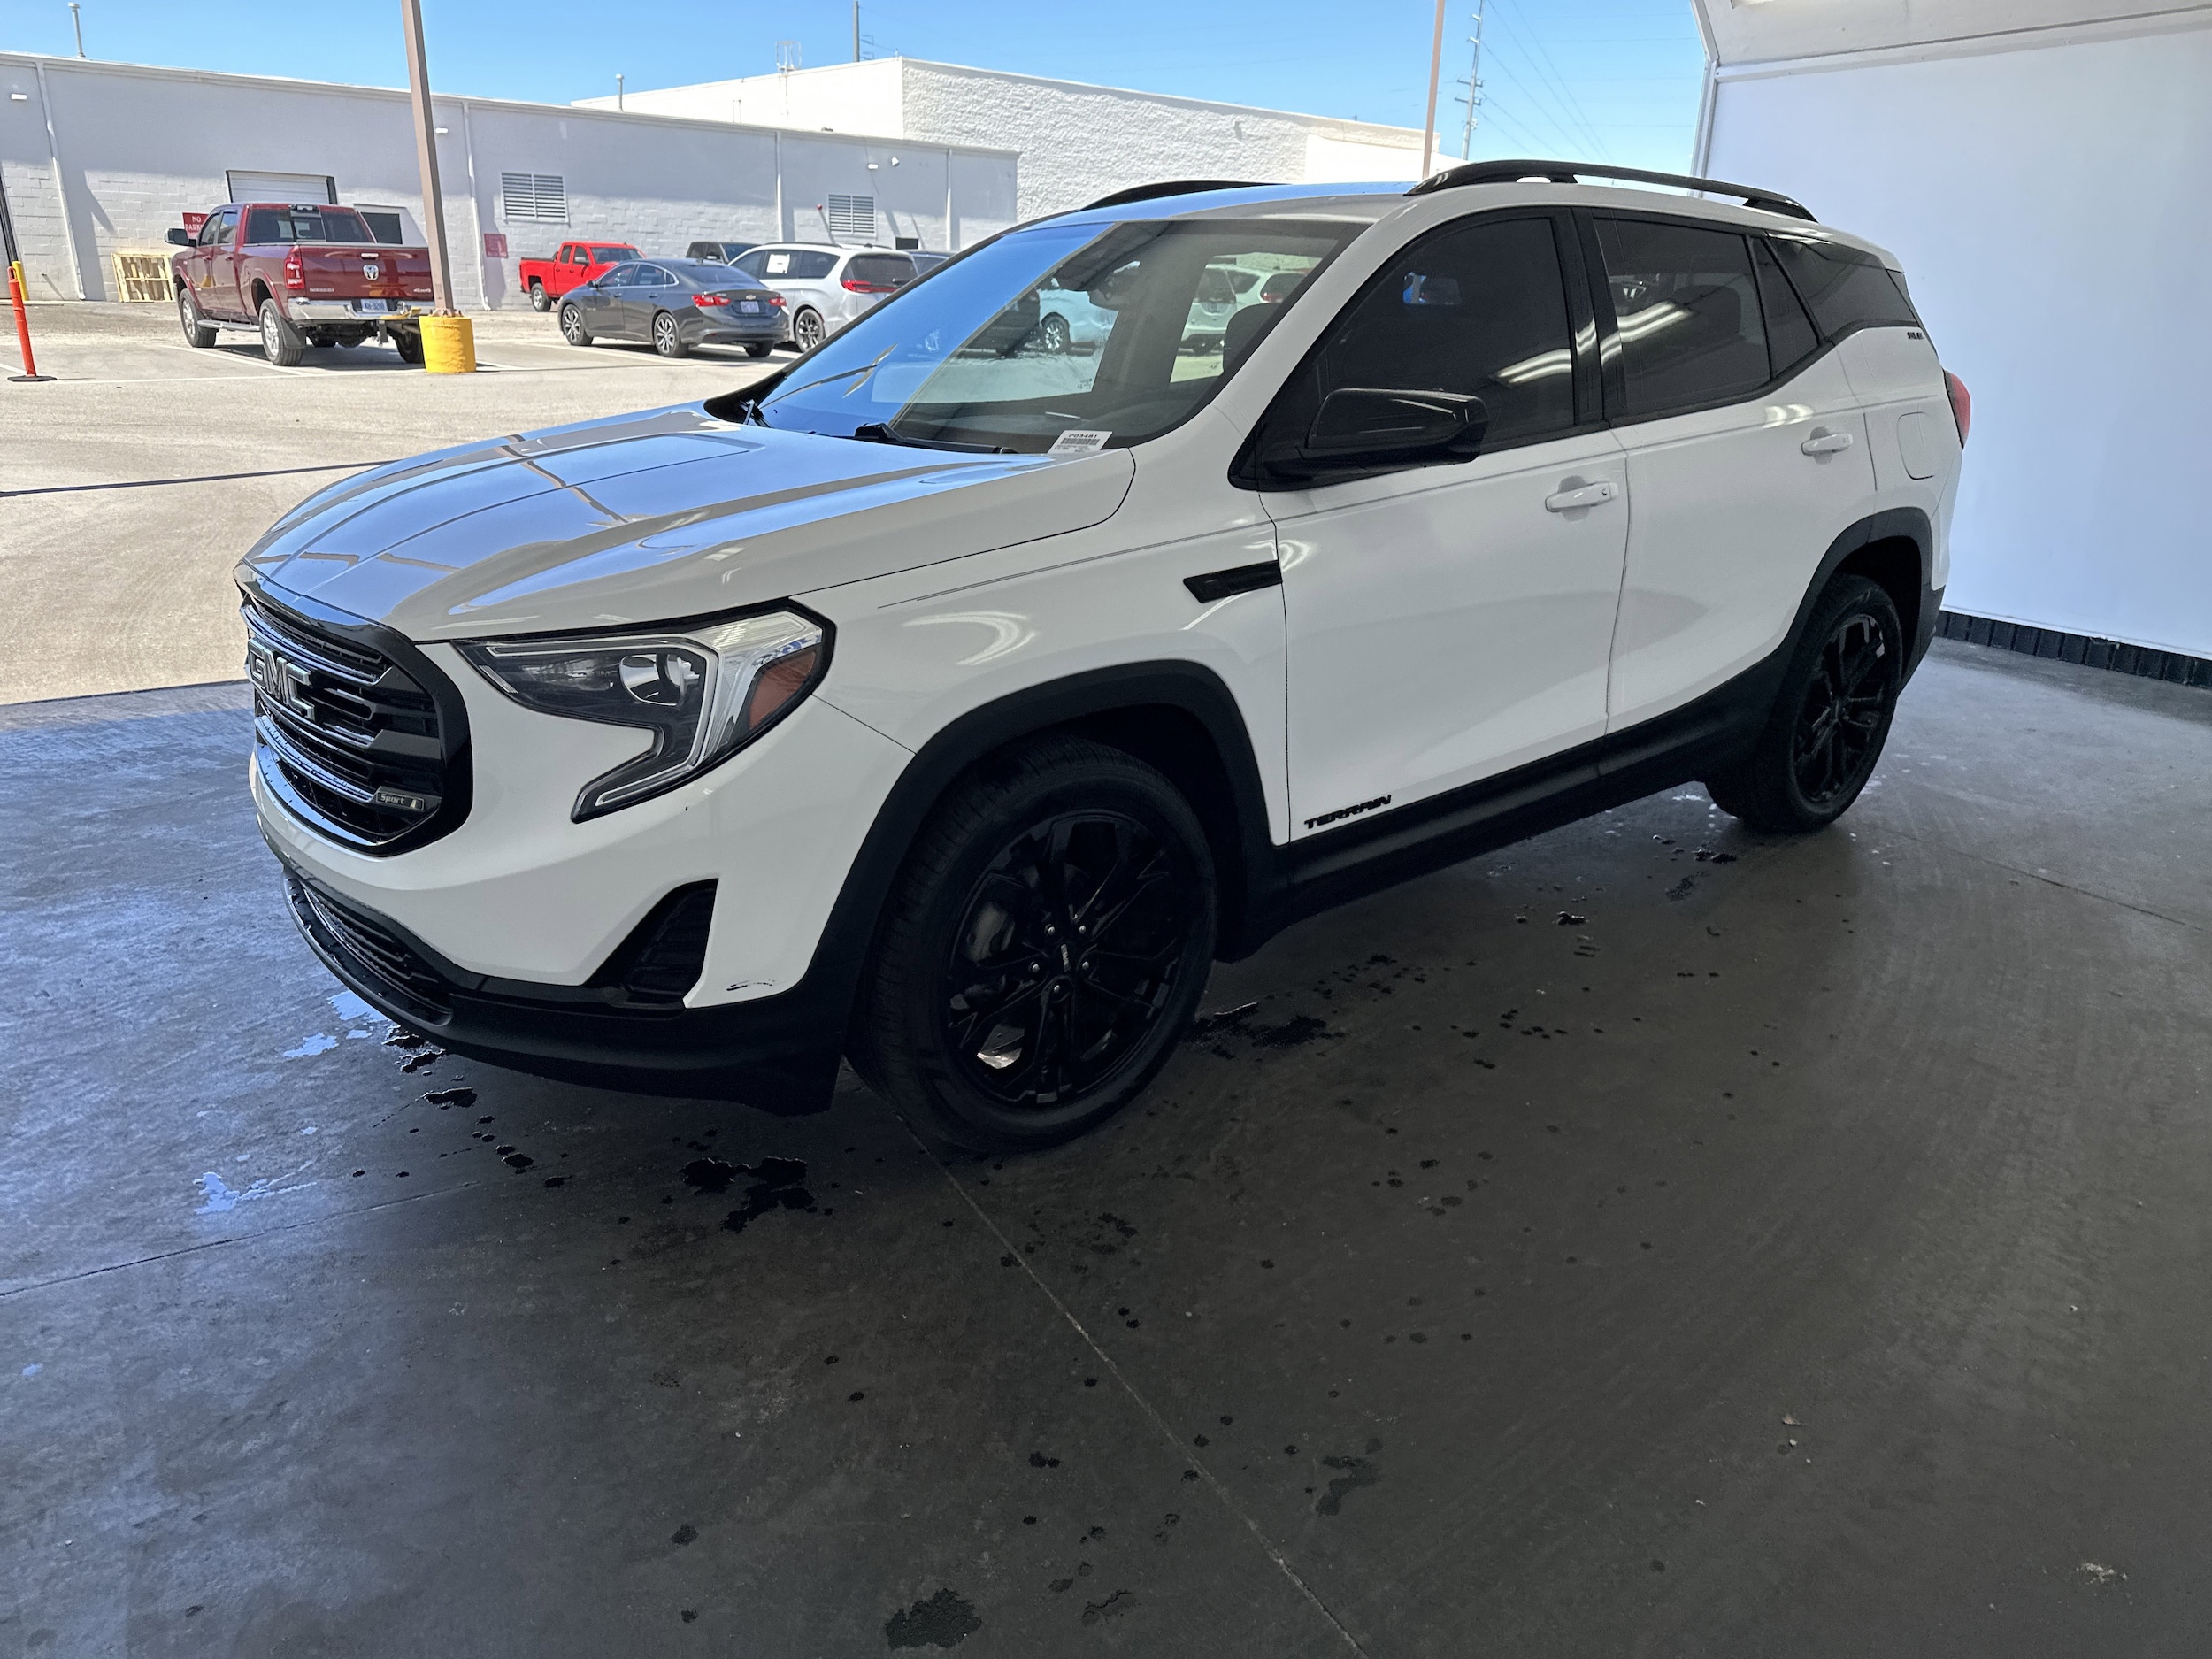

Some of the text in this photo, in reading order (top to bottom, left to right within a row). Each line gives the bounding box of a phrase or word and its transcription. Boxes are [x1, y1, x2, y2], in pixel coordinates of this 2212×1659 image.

[248, 638, 316, 721] GMC
[380, 793, 405, 804] Sport
[1304, 795, 1392, 829] TERRAIN
